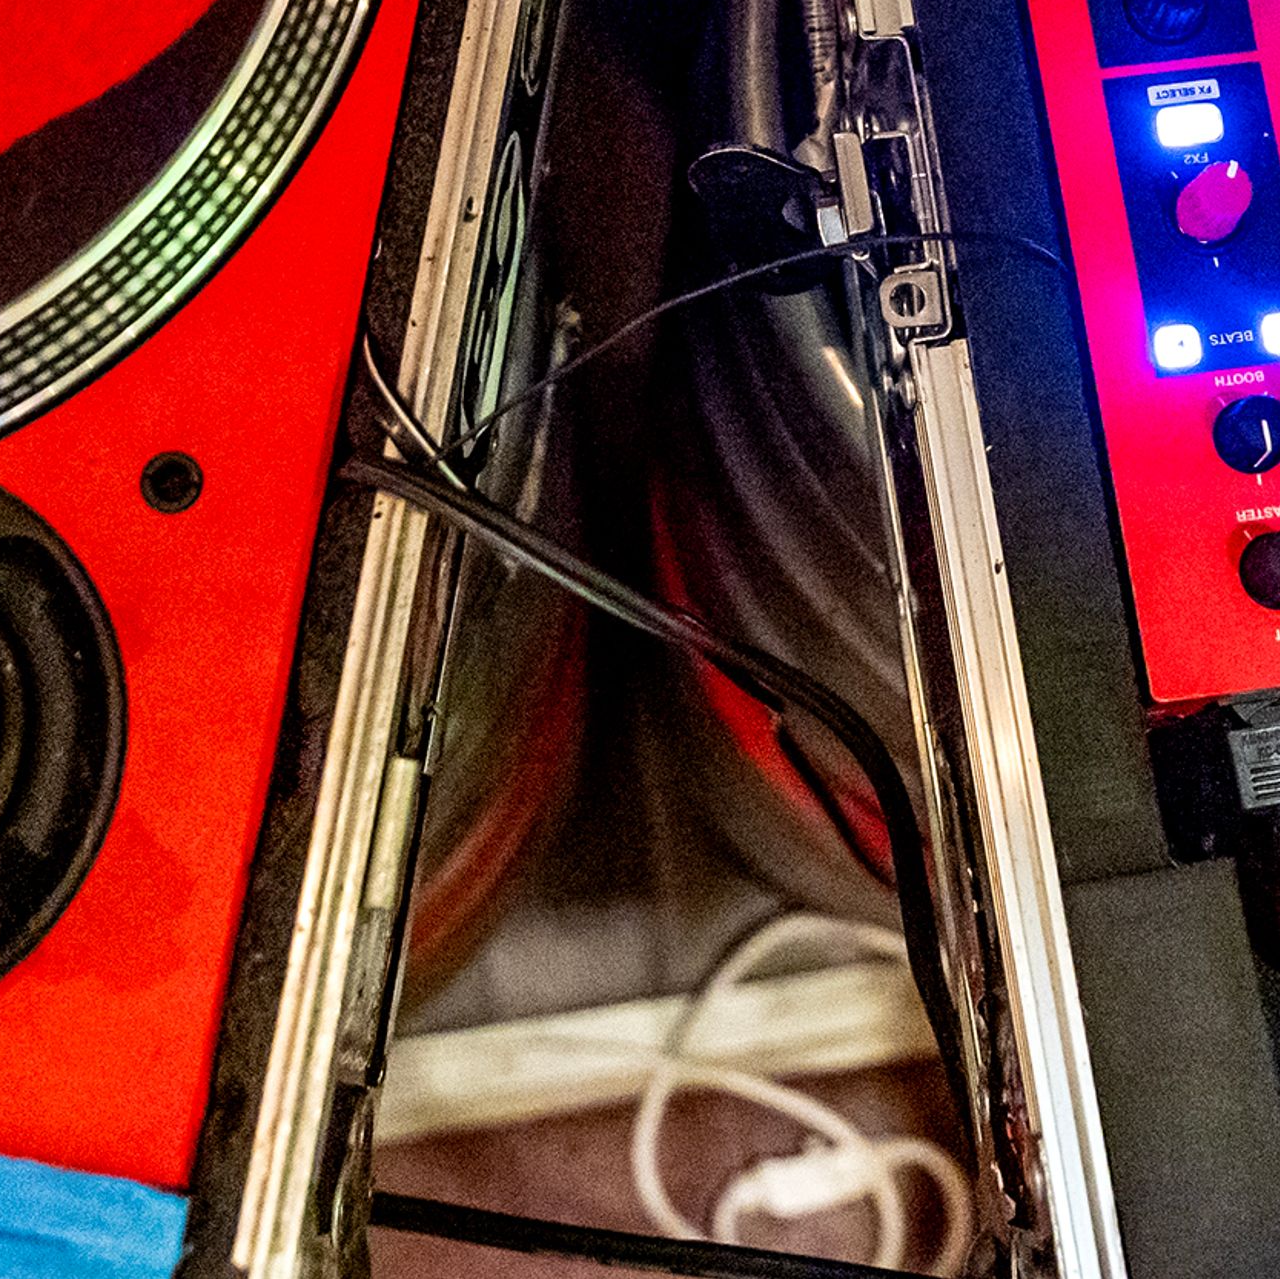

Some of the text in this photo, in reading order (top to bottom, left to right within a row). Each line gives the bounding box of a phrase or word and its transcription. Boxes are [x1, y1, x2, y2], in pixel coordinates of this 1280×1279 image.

[1154, 85, 1213, 101] FX SELECT
[1183, 151, 1210, 165] FX2
[1208, 329, 1256, 347] BEATS
[1214, 369, 1265, 387] BOOTH
